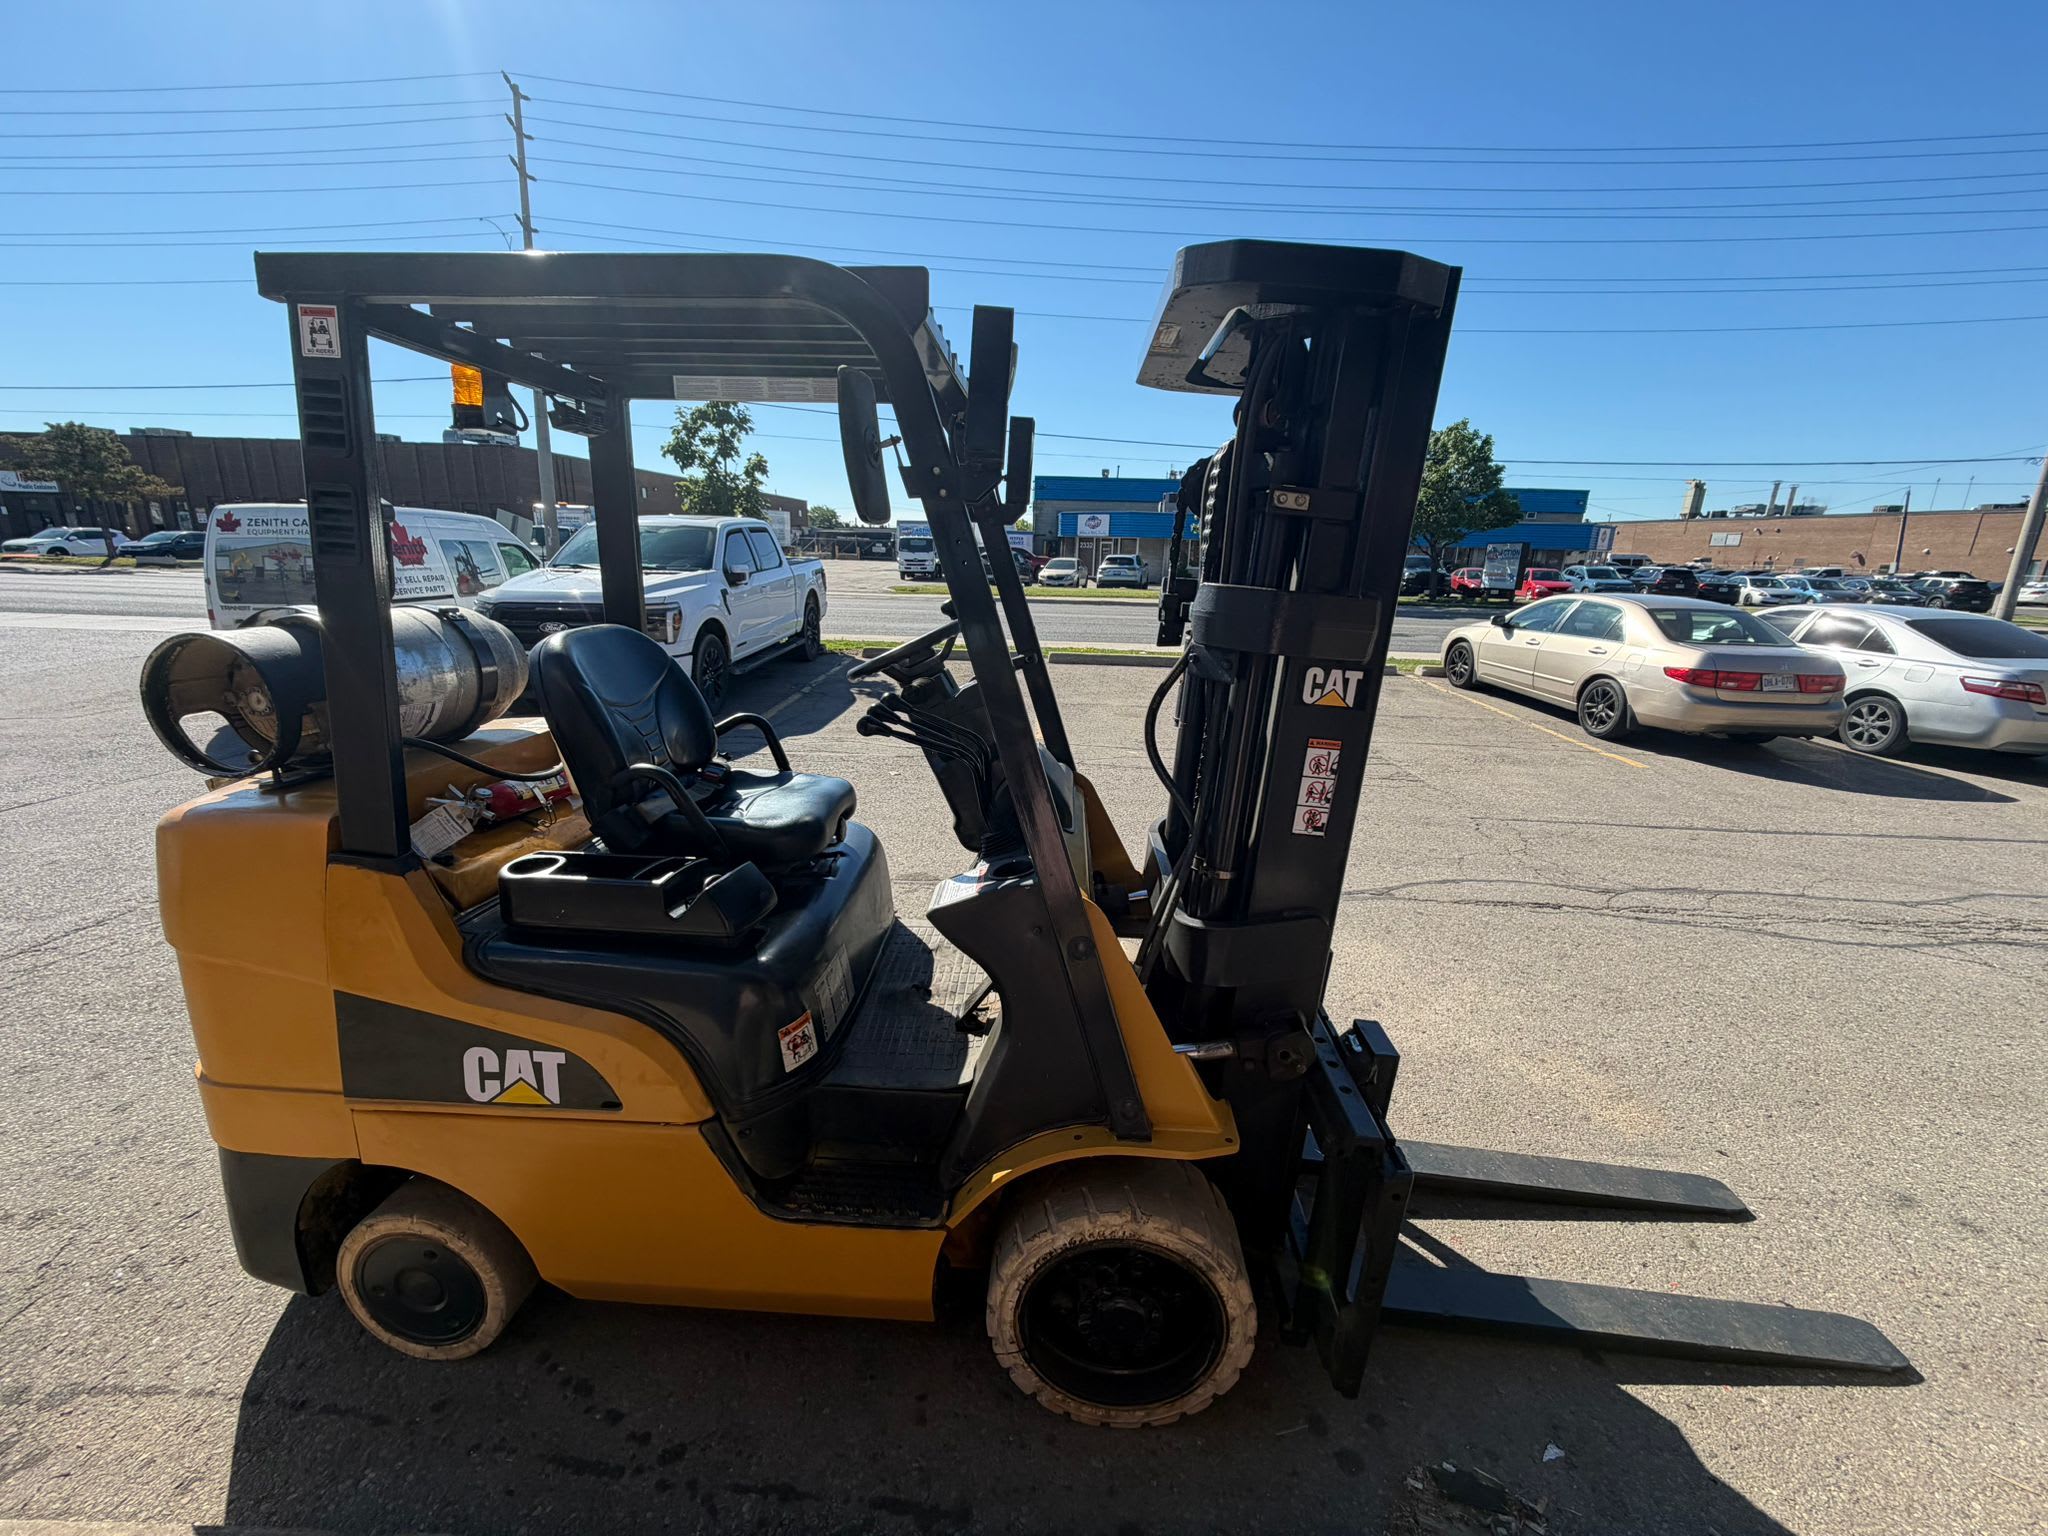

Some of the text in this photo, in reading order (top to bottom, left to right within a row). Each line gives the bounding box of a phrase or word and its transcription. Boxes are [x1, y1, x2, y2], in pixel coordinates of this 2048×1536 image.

[247, 518, 309, 527] ZENITH CA
[247, 528, 295, 536] EQUIPMENT
[404, 575, 422, 583] SELL
[422, 574, 446, 583] REPAIR
[395, 585, 446, 596] SERVICE PARTS
[1302, 666, 1364, 708] CAT
[1315, 740, 1341, 748] WARNING
[463, 1046, 566, 1104] CAT
